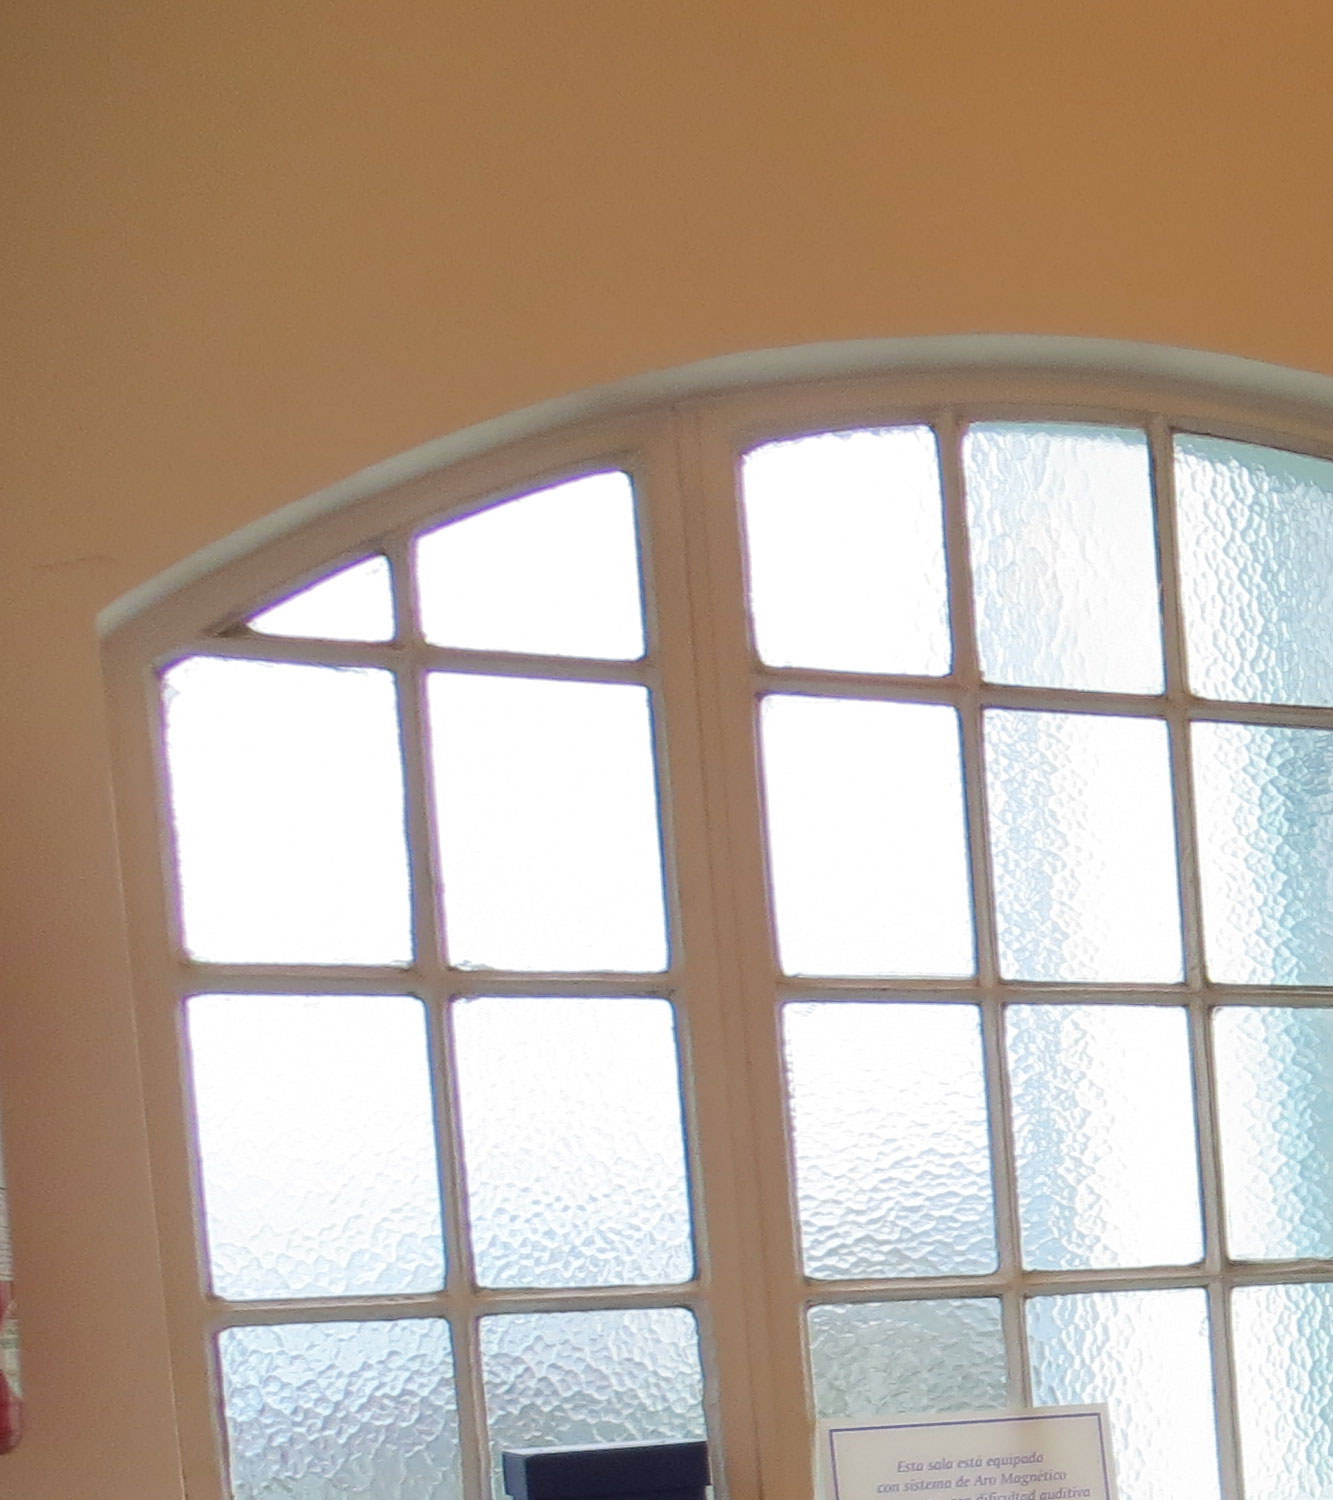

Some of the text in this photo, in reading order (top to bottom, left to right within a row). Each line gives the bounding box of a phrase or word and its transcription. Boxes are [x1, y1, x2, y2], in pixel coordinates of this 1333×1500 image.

[897, 1452, 1044, 1474] Esta sala está equipada
[877, 1470, 1068, 1494] con sistema de Aro Magnético
[1039, 1487, 1091, 1500] auditiva
